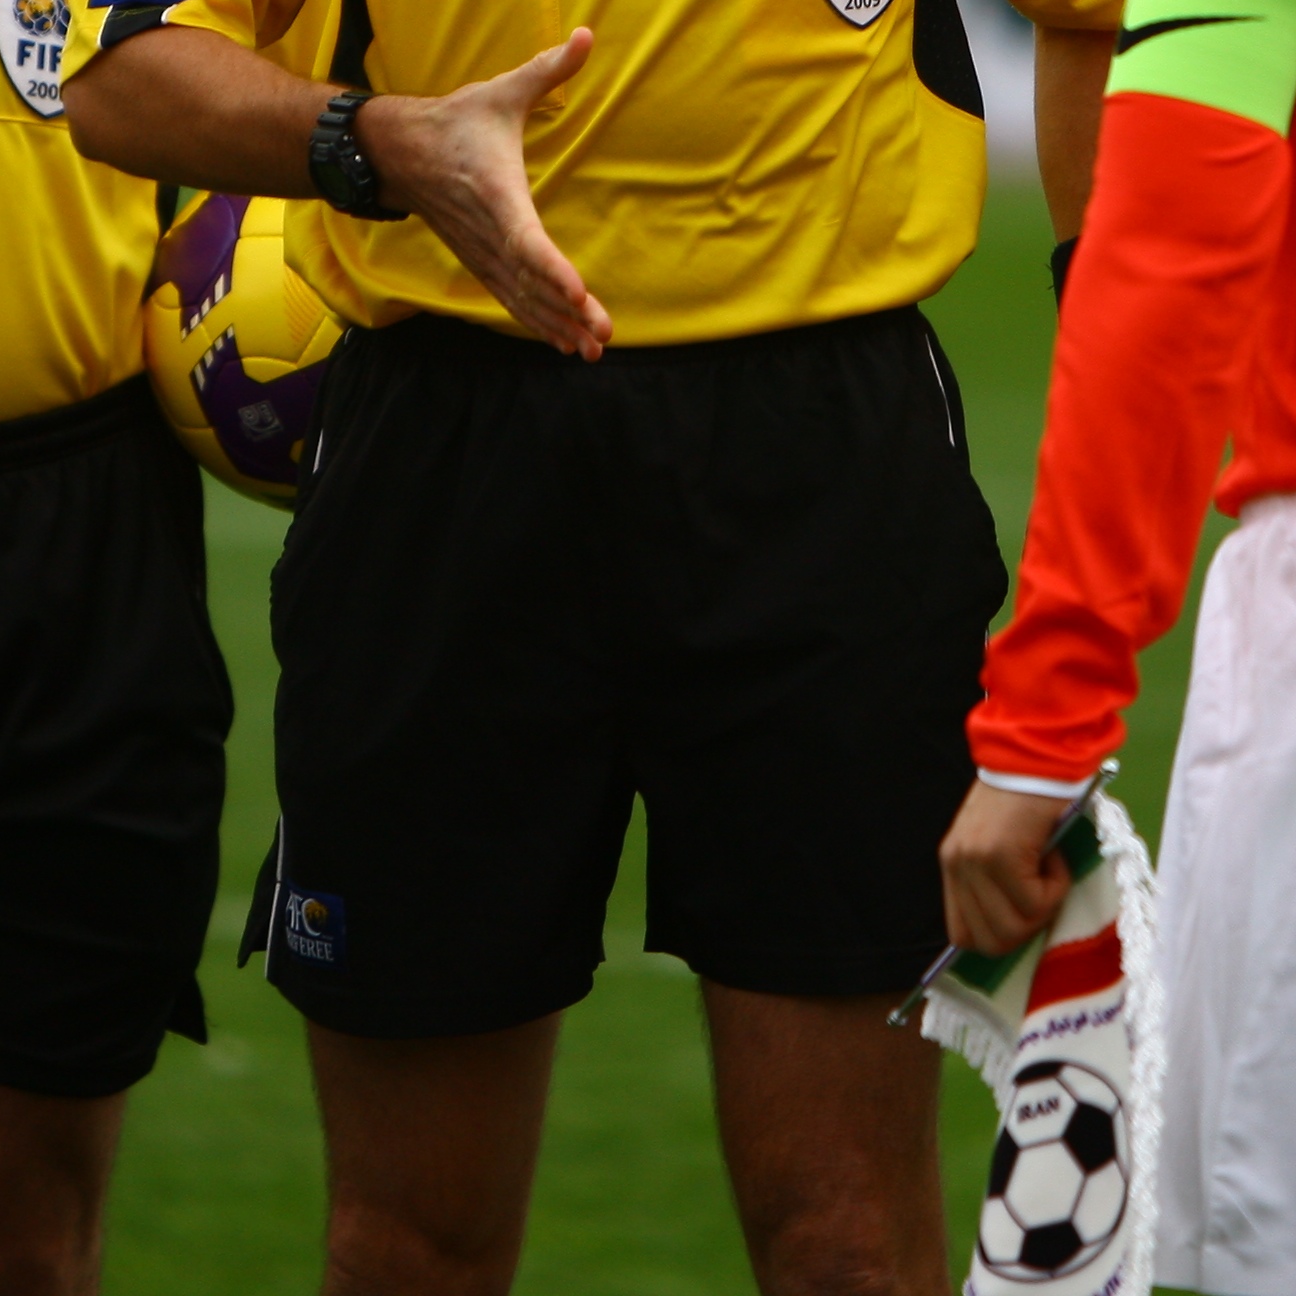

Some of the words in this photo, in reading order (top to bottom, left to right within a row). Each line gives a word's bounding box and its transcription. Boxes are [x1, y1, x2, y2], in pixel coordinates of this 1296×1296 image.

[16, 38, 62, 73] FIF
[26, 79, 60, 101] 200
[1017, 1096, 1060, 1124] IRAN
